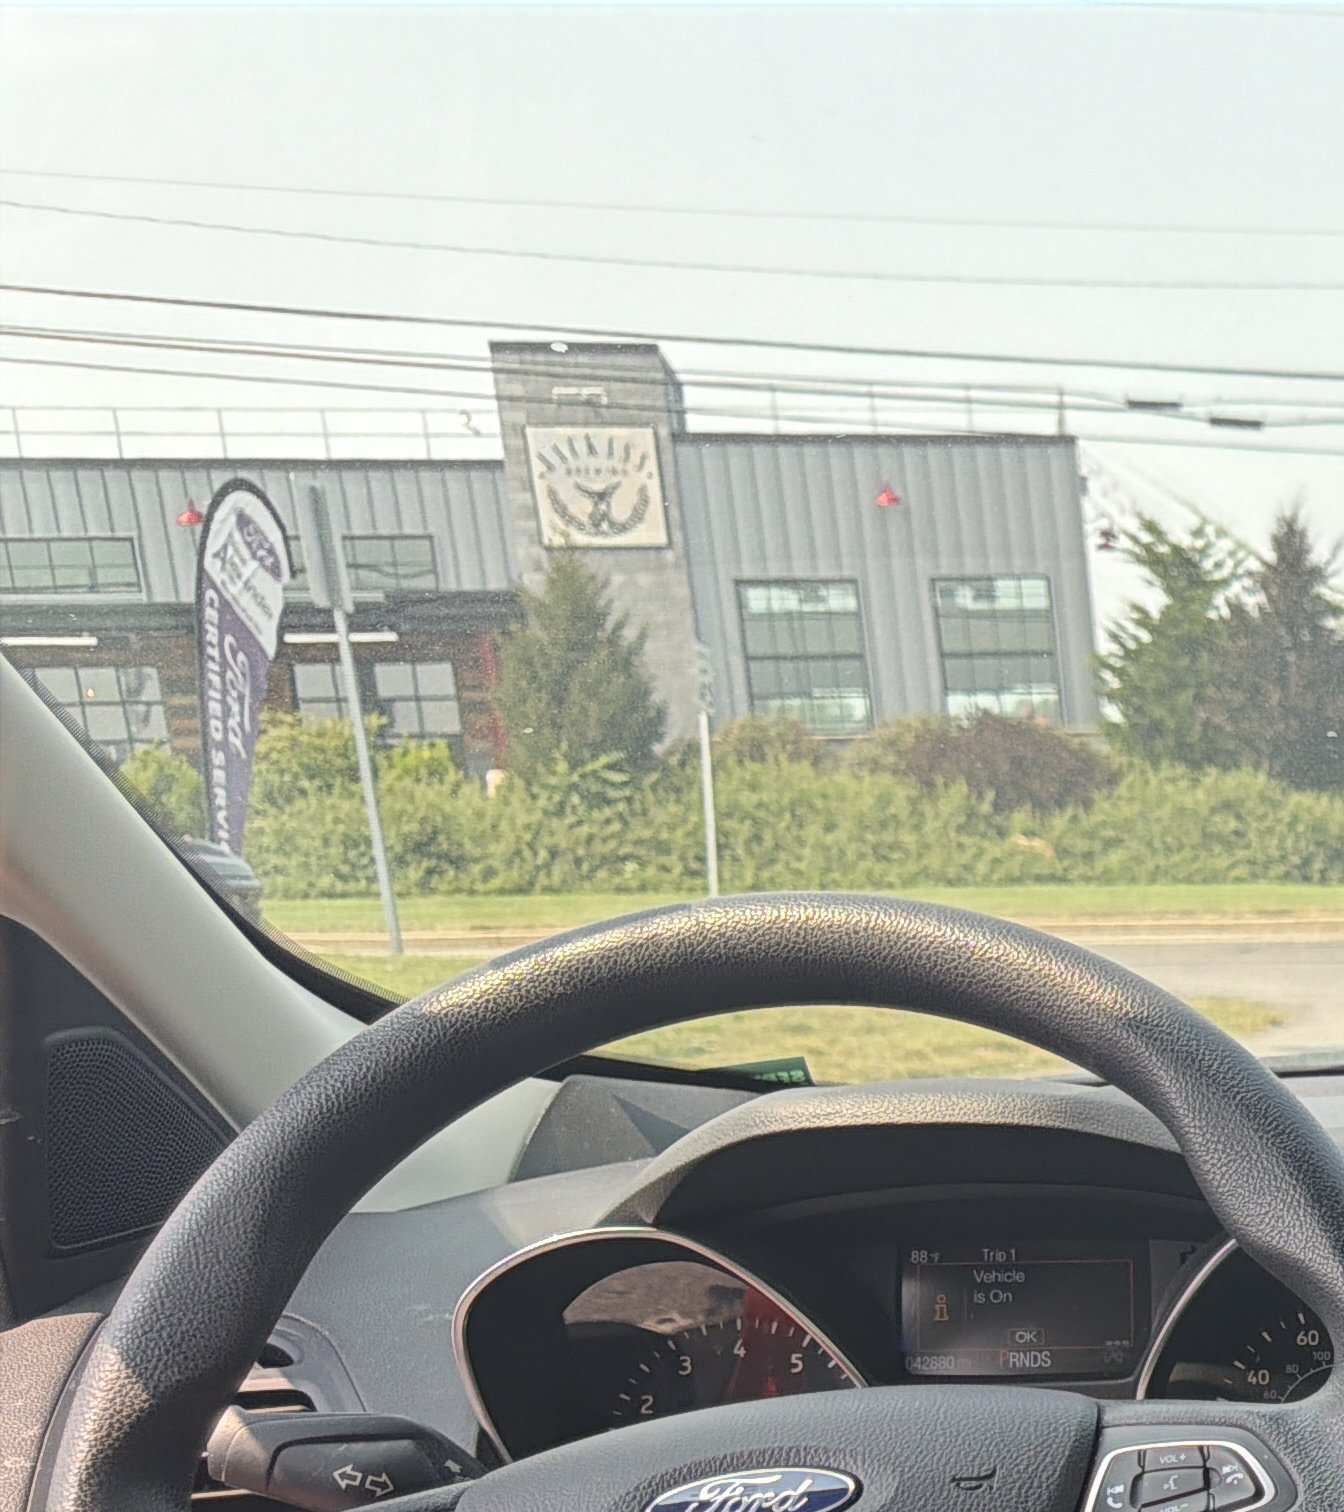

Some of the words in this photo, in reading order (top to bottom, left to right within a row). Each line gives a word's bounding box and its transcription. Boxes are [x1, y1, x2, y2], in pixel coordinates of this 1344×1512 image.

[204, 588, 222, 741] CERTIFIED
[223, 633, 250, 760] Ford
[983, 1249, 1006, 1263] Trip
[1010, 1249, 1016, 1262] 1
[973, 1269, 1026, 1283] Vehicle
[973, 1290, 986, 1304] is
[990, 1289, 1013, 1303] On
[1015, 1331, 1038, 1343] OK
[1296, 1330, 1319, 1346] 60
[733, 1339, 747, 1358] 4
[1312, 1351, 1331, 1361] 100
[678, 1356, 692, 1376] 3
[790, 1353, 804, 1373] 5
[905, 1356, 955, 1370] 042880
[1286, 1364, 1299, 1375] 80
[1247, 1369, 1270, 1385] 40
[1263, 1389, 1278, 1400] 60
[640, 1395, 654, 1414] 2
